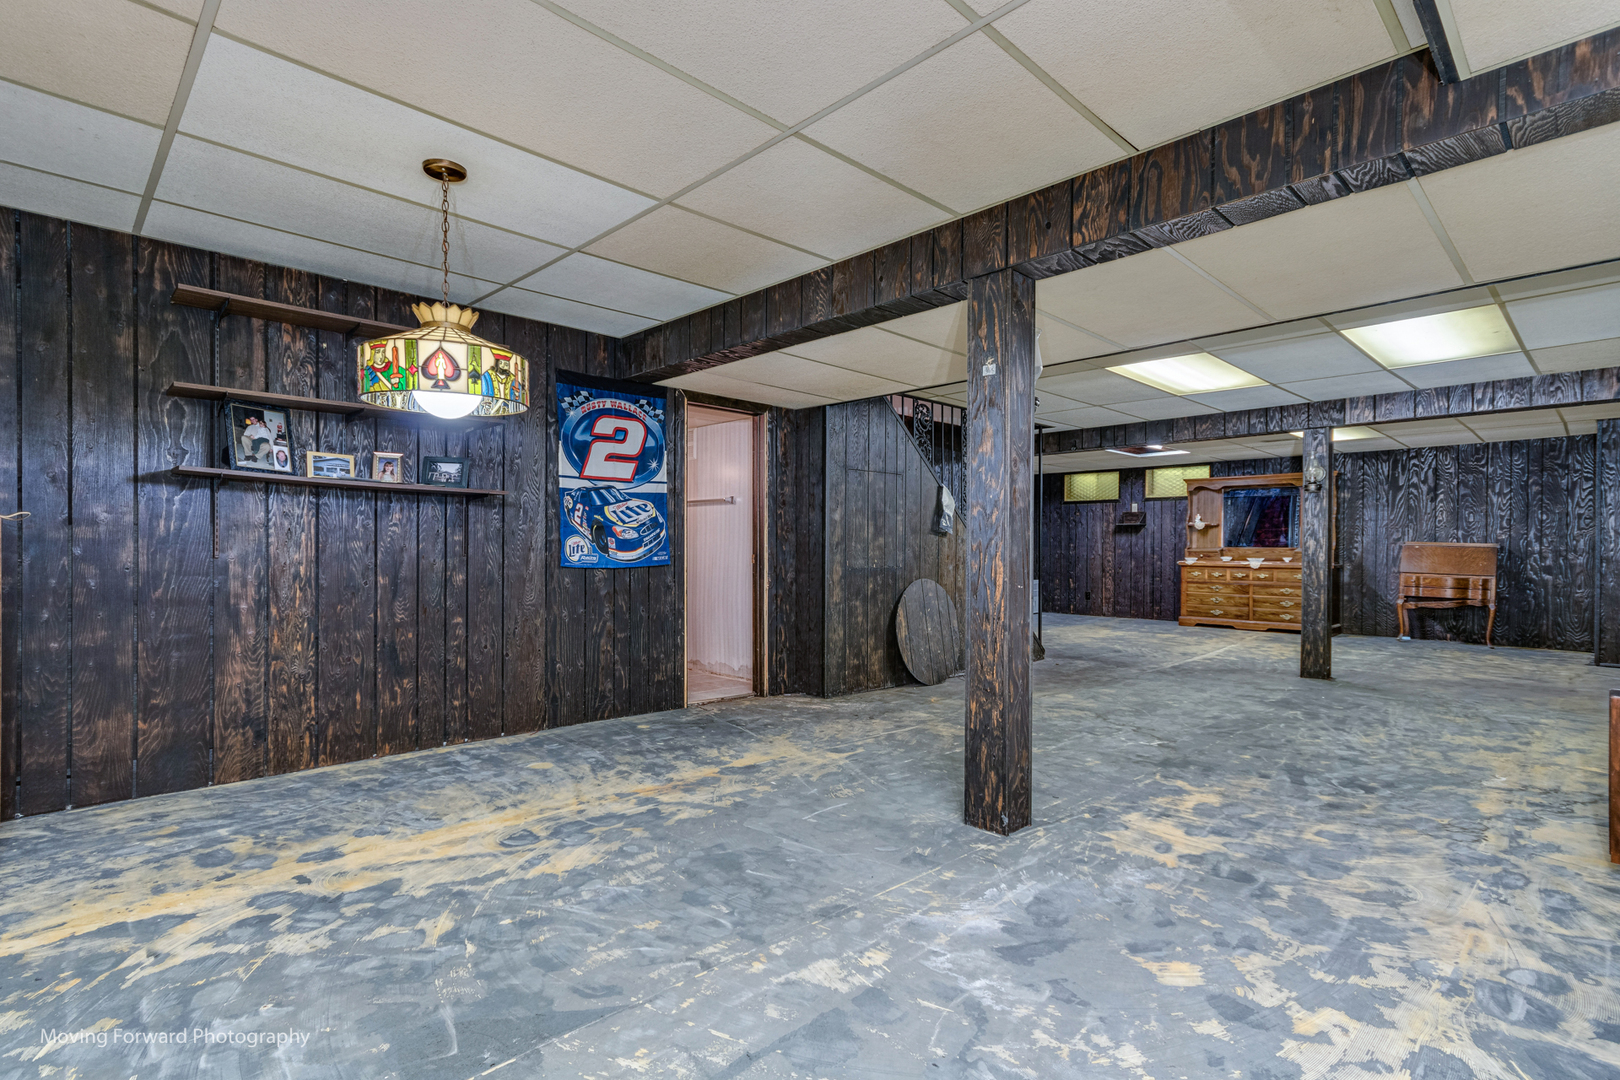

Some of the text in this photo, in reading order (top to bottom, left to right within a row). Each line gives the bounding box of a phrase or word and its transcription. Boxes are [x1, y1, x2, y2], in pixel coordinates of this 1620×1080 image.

[581, 401, 646, 421] RUSTY WALLACE
[580, 415, 647, 482] 2
[610, 503, 650, 523] Lite
[568, 544, 585, 557] Lite
